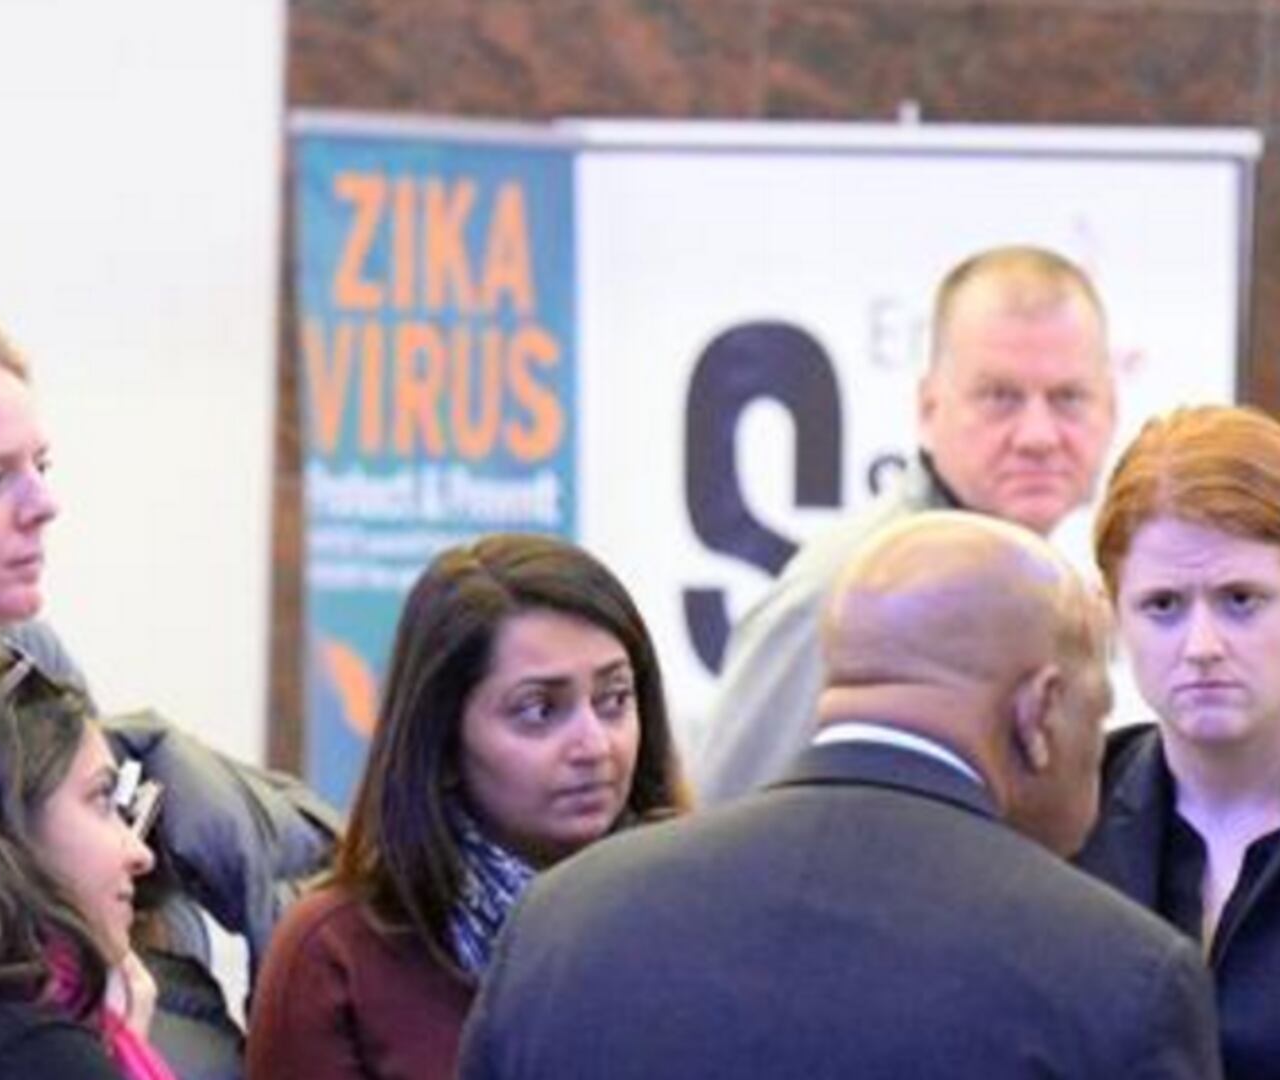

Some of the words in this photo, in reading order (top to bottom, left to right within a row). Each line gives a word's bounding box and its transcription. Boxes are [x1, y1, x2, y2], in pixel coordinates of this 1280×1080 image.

[332, 171, 534, 311] ZIKA
[303, 318, 564, 461] VIRUS
[683, 319, 843, 678] S
